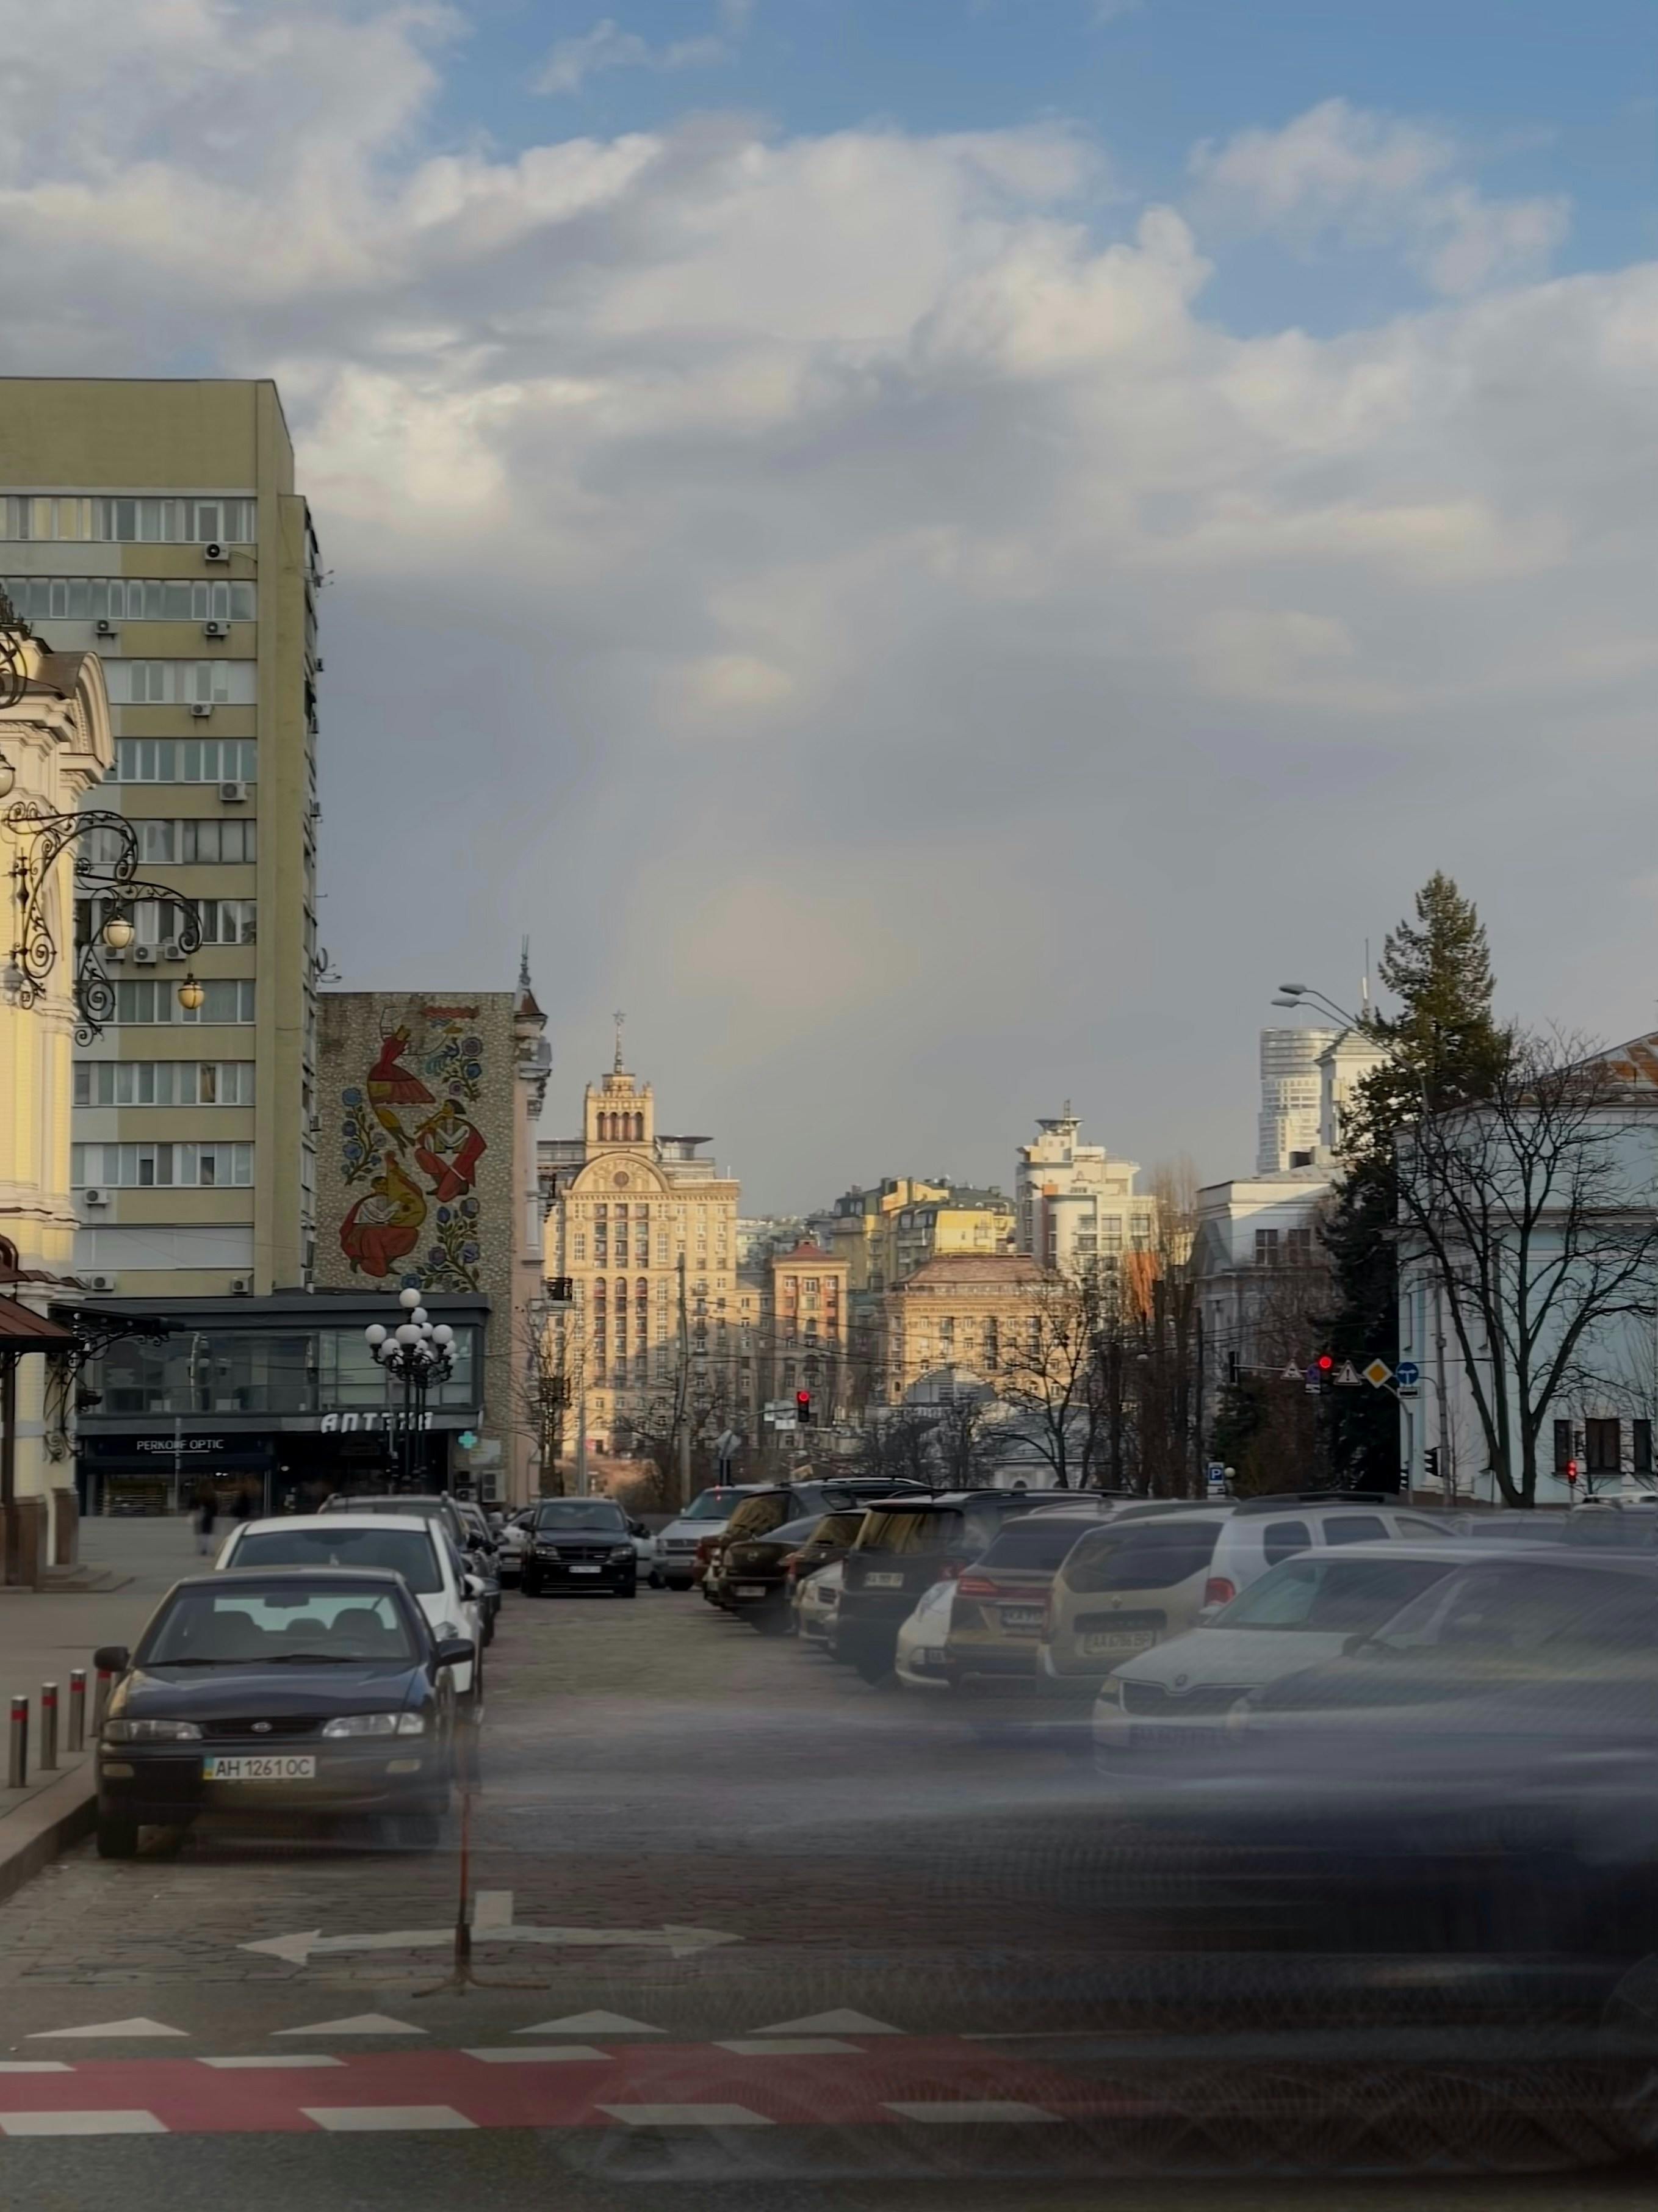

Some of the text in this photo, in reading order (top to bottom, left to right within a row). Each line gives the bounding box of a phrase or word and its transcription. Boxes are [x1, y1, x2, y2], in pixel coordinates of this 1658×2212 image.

[189, 1439, 225, 1449] OPTIC
[1211, 1469, 1221, 1478] P
[215, 1759, 310, 1776] AH 1261 OC
